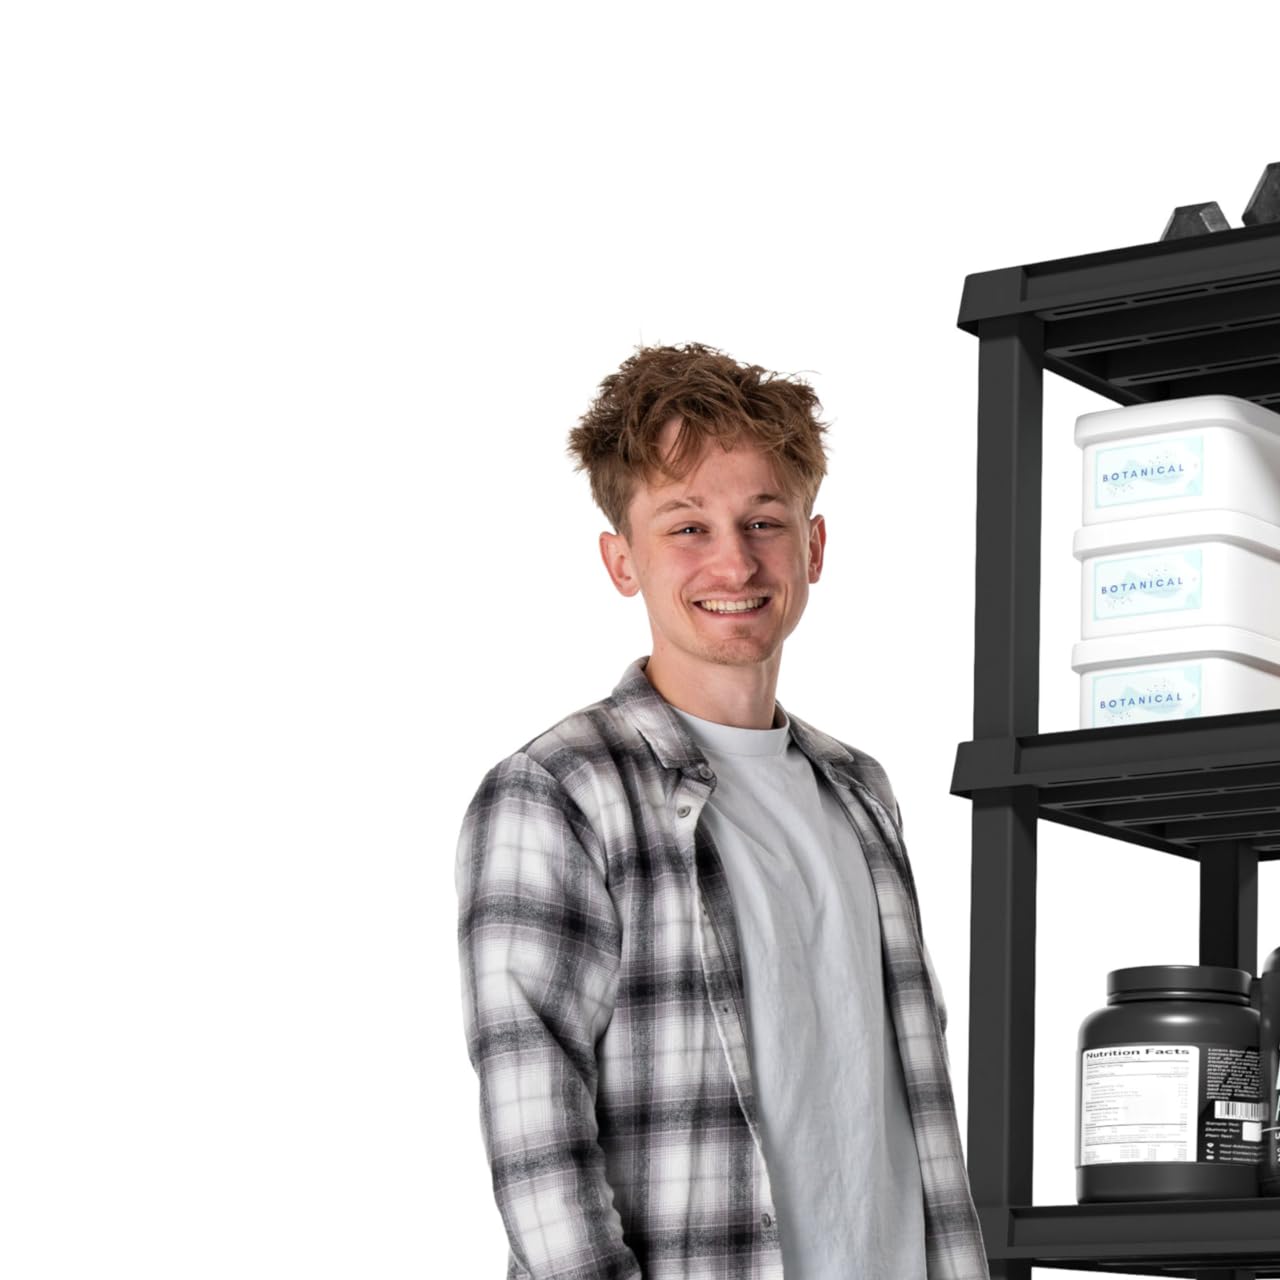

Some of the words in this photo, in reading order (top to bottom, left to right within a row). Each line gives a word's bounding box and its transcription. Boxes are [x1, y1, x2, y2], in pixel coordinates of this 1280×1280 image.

[1102, 463, 1185, 483] BOTANICAL
[1101, 576, 1184, 595] BOTANICAL
[1100, 692, 1183, 709] BOTANICAL
[1086, 1050, 1140, 1059] Nutrition
